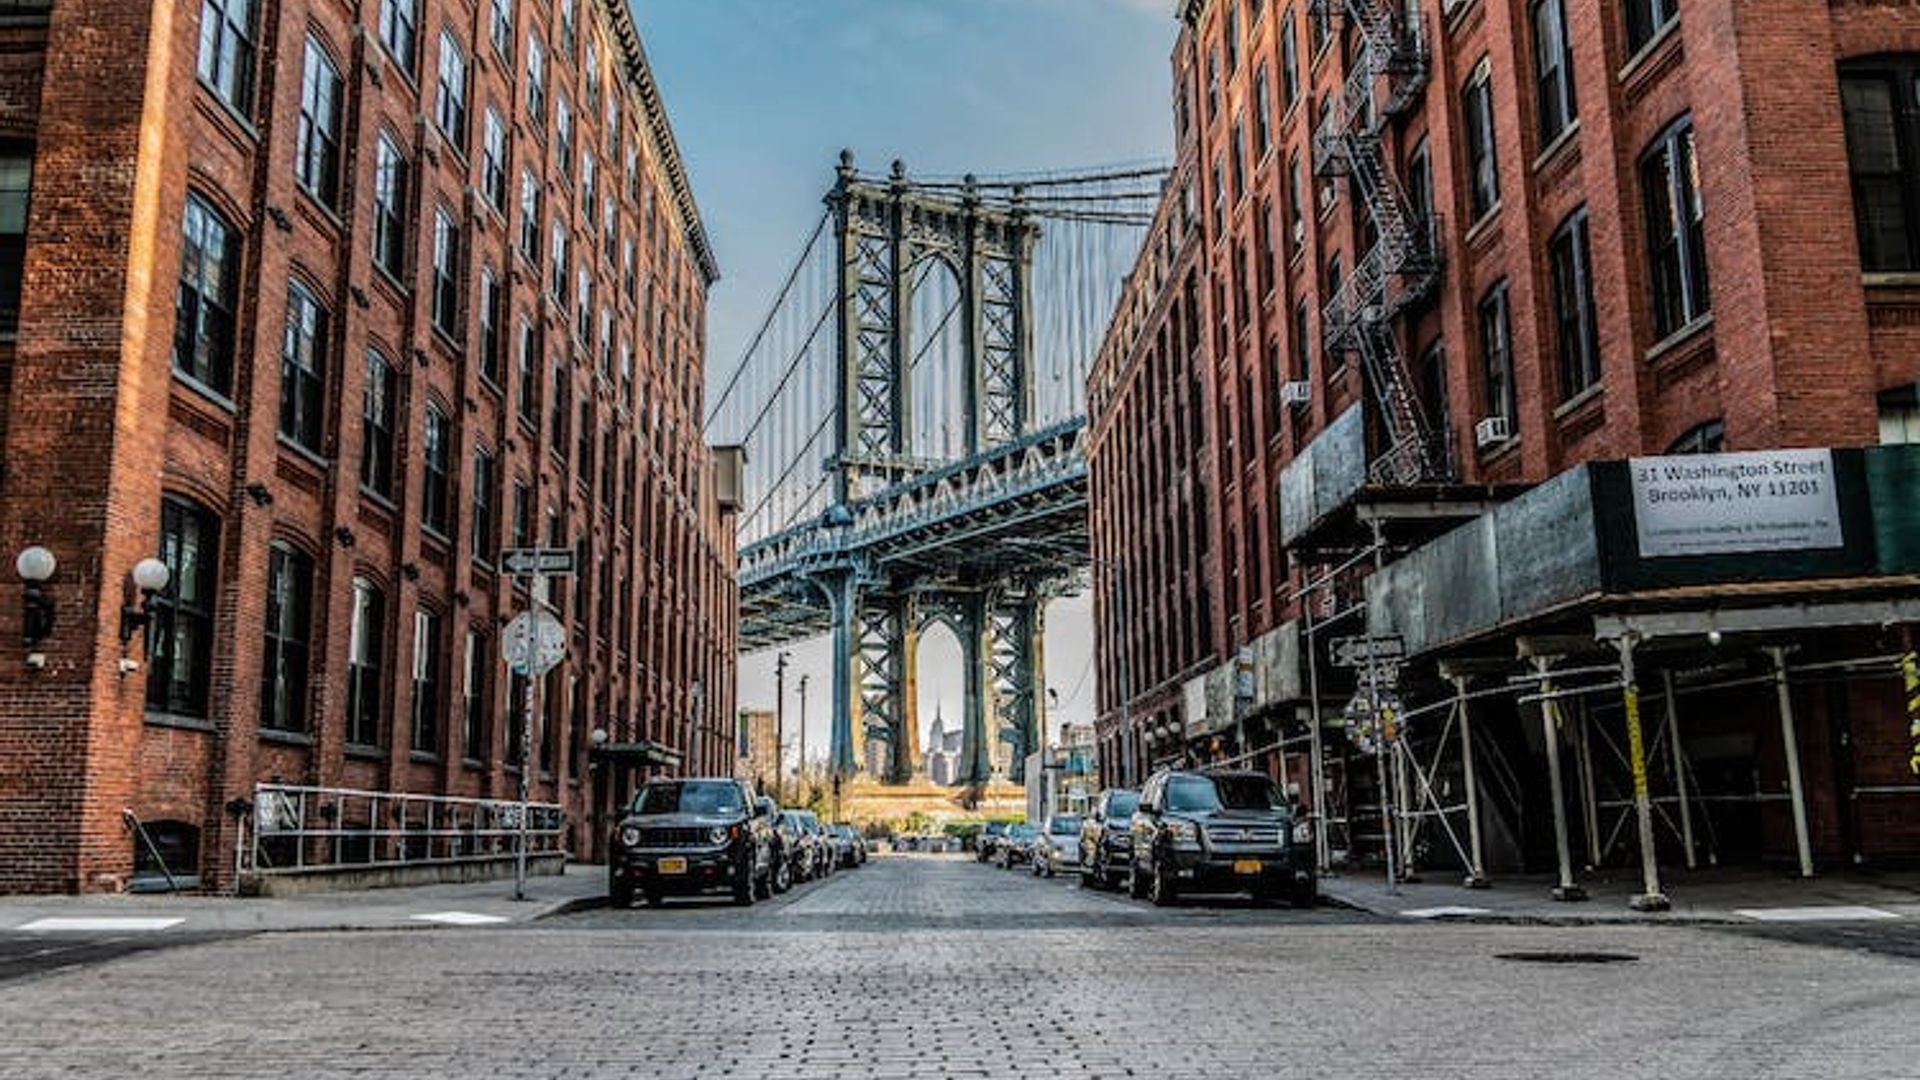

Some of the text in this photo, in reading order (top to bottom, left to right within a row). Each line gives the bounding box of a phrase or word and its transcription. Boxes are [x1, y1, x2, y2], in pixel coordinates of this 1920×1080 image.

[1637, 459, 1826, 483] 31 Washington Street
[1648, 479, 1820, 504] Brooklyn, NY 11201
